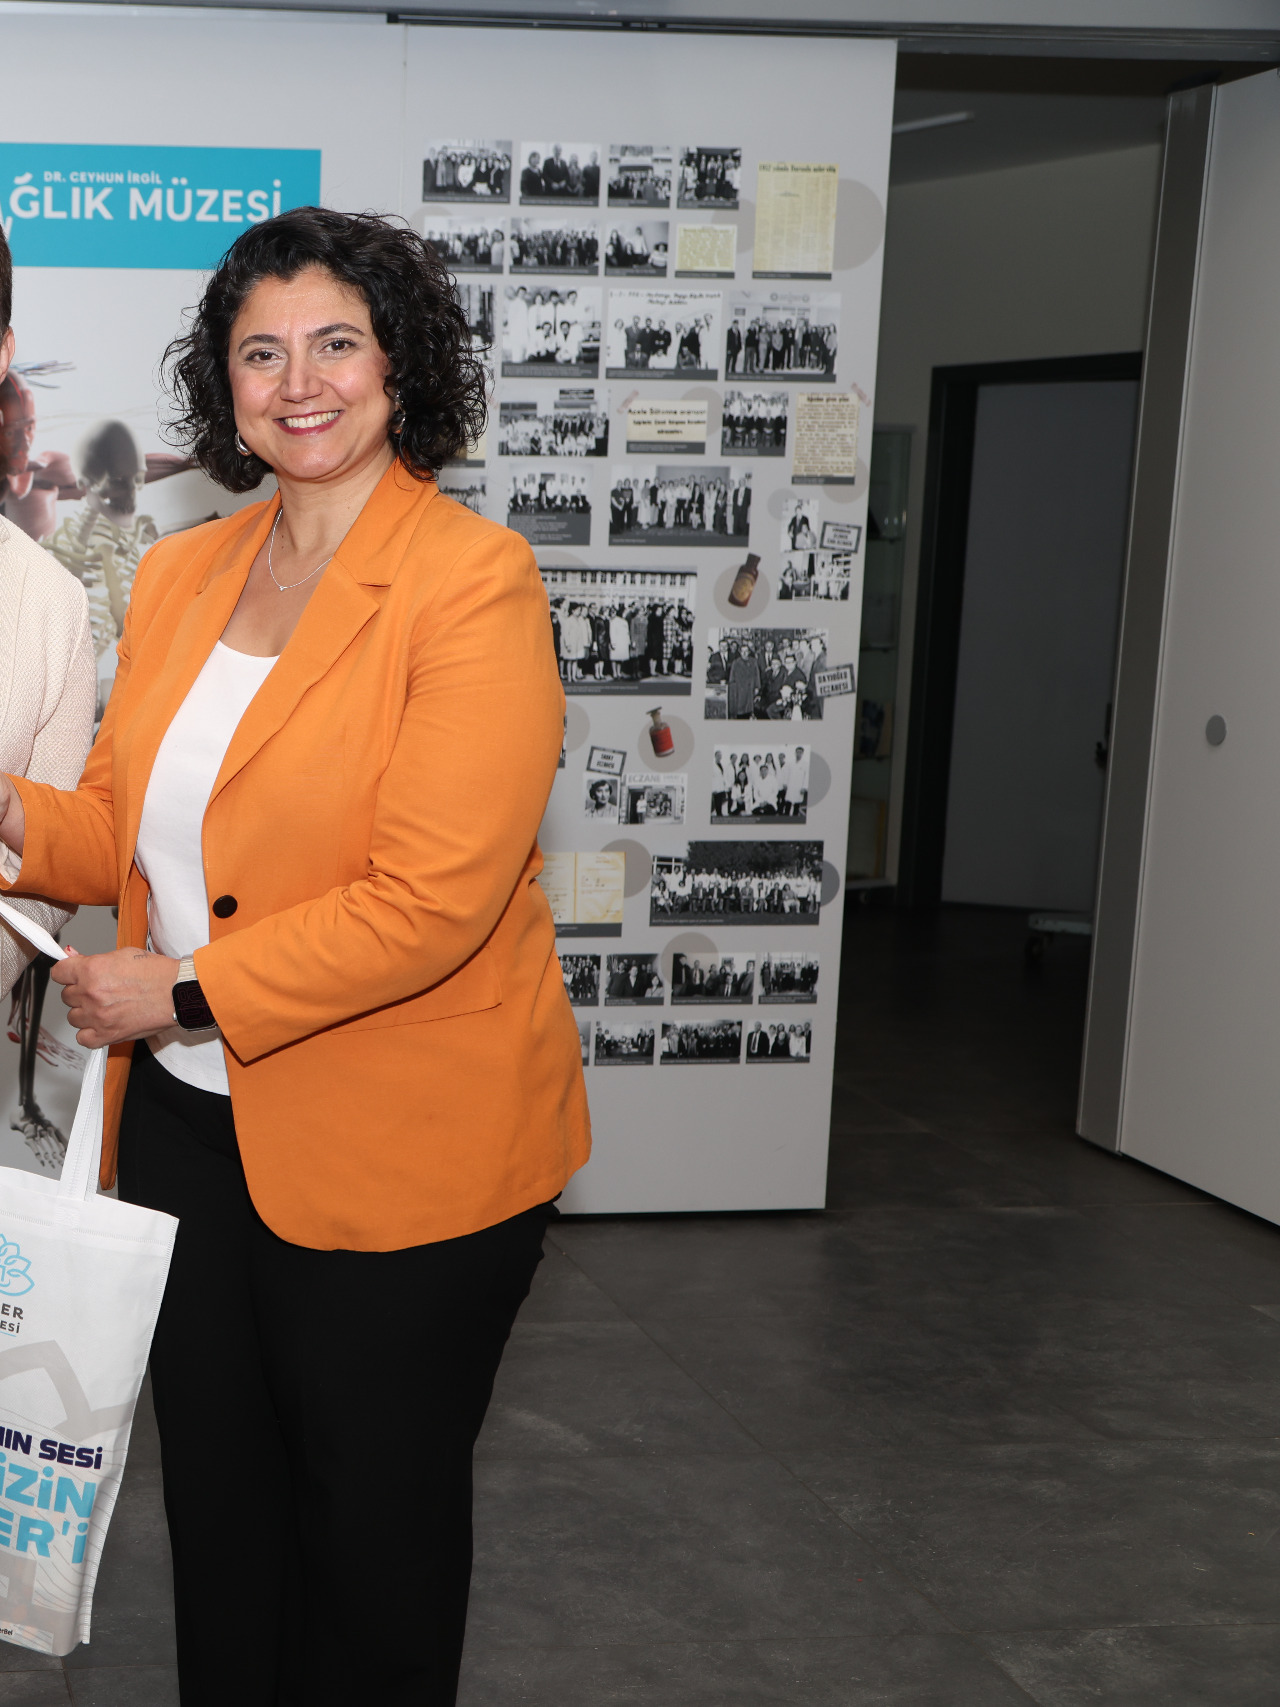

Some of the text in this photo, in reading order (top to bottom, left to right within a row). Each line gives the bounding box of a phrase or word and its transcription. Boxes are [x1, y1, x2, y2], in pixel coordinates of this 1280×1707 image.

[43, 170, 163, 185] DR. CEYHUN İRGİL
[128, 177, 282, 222] MÜZESİ
[38, 1438, 103, 1470] SESİ
